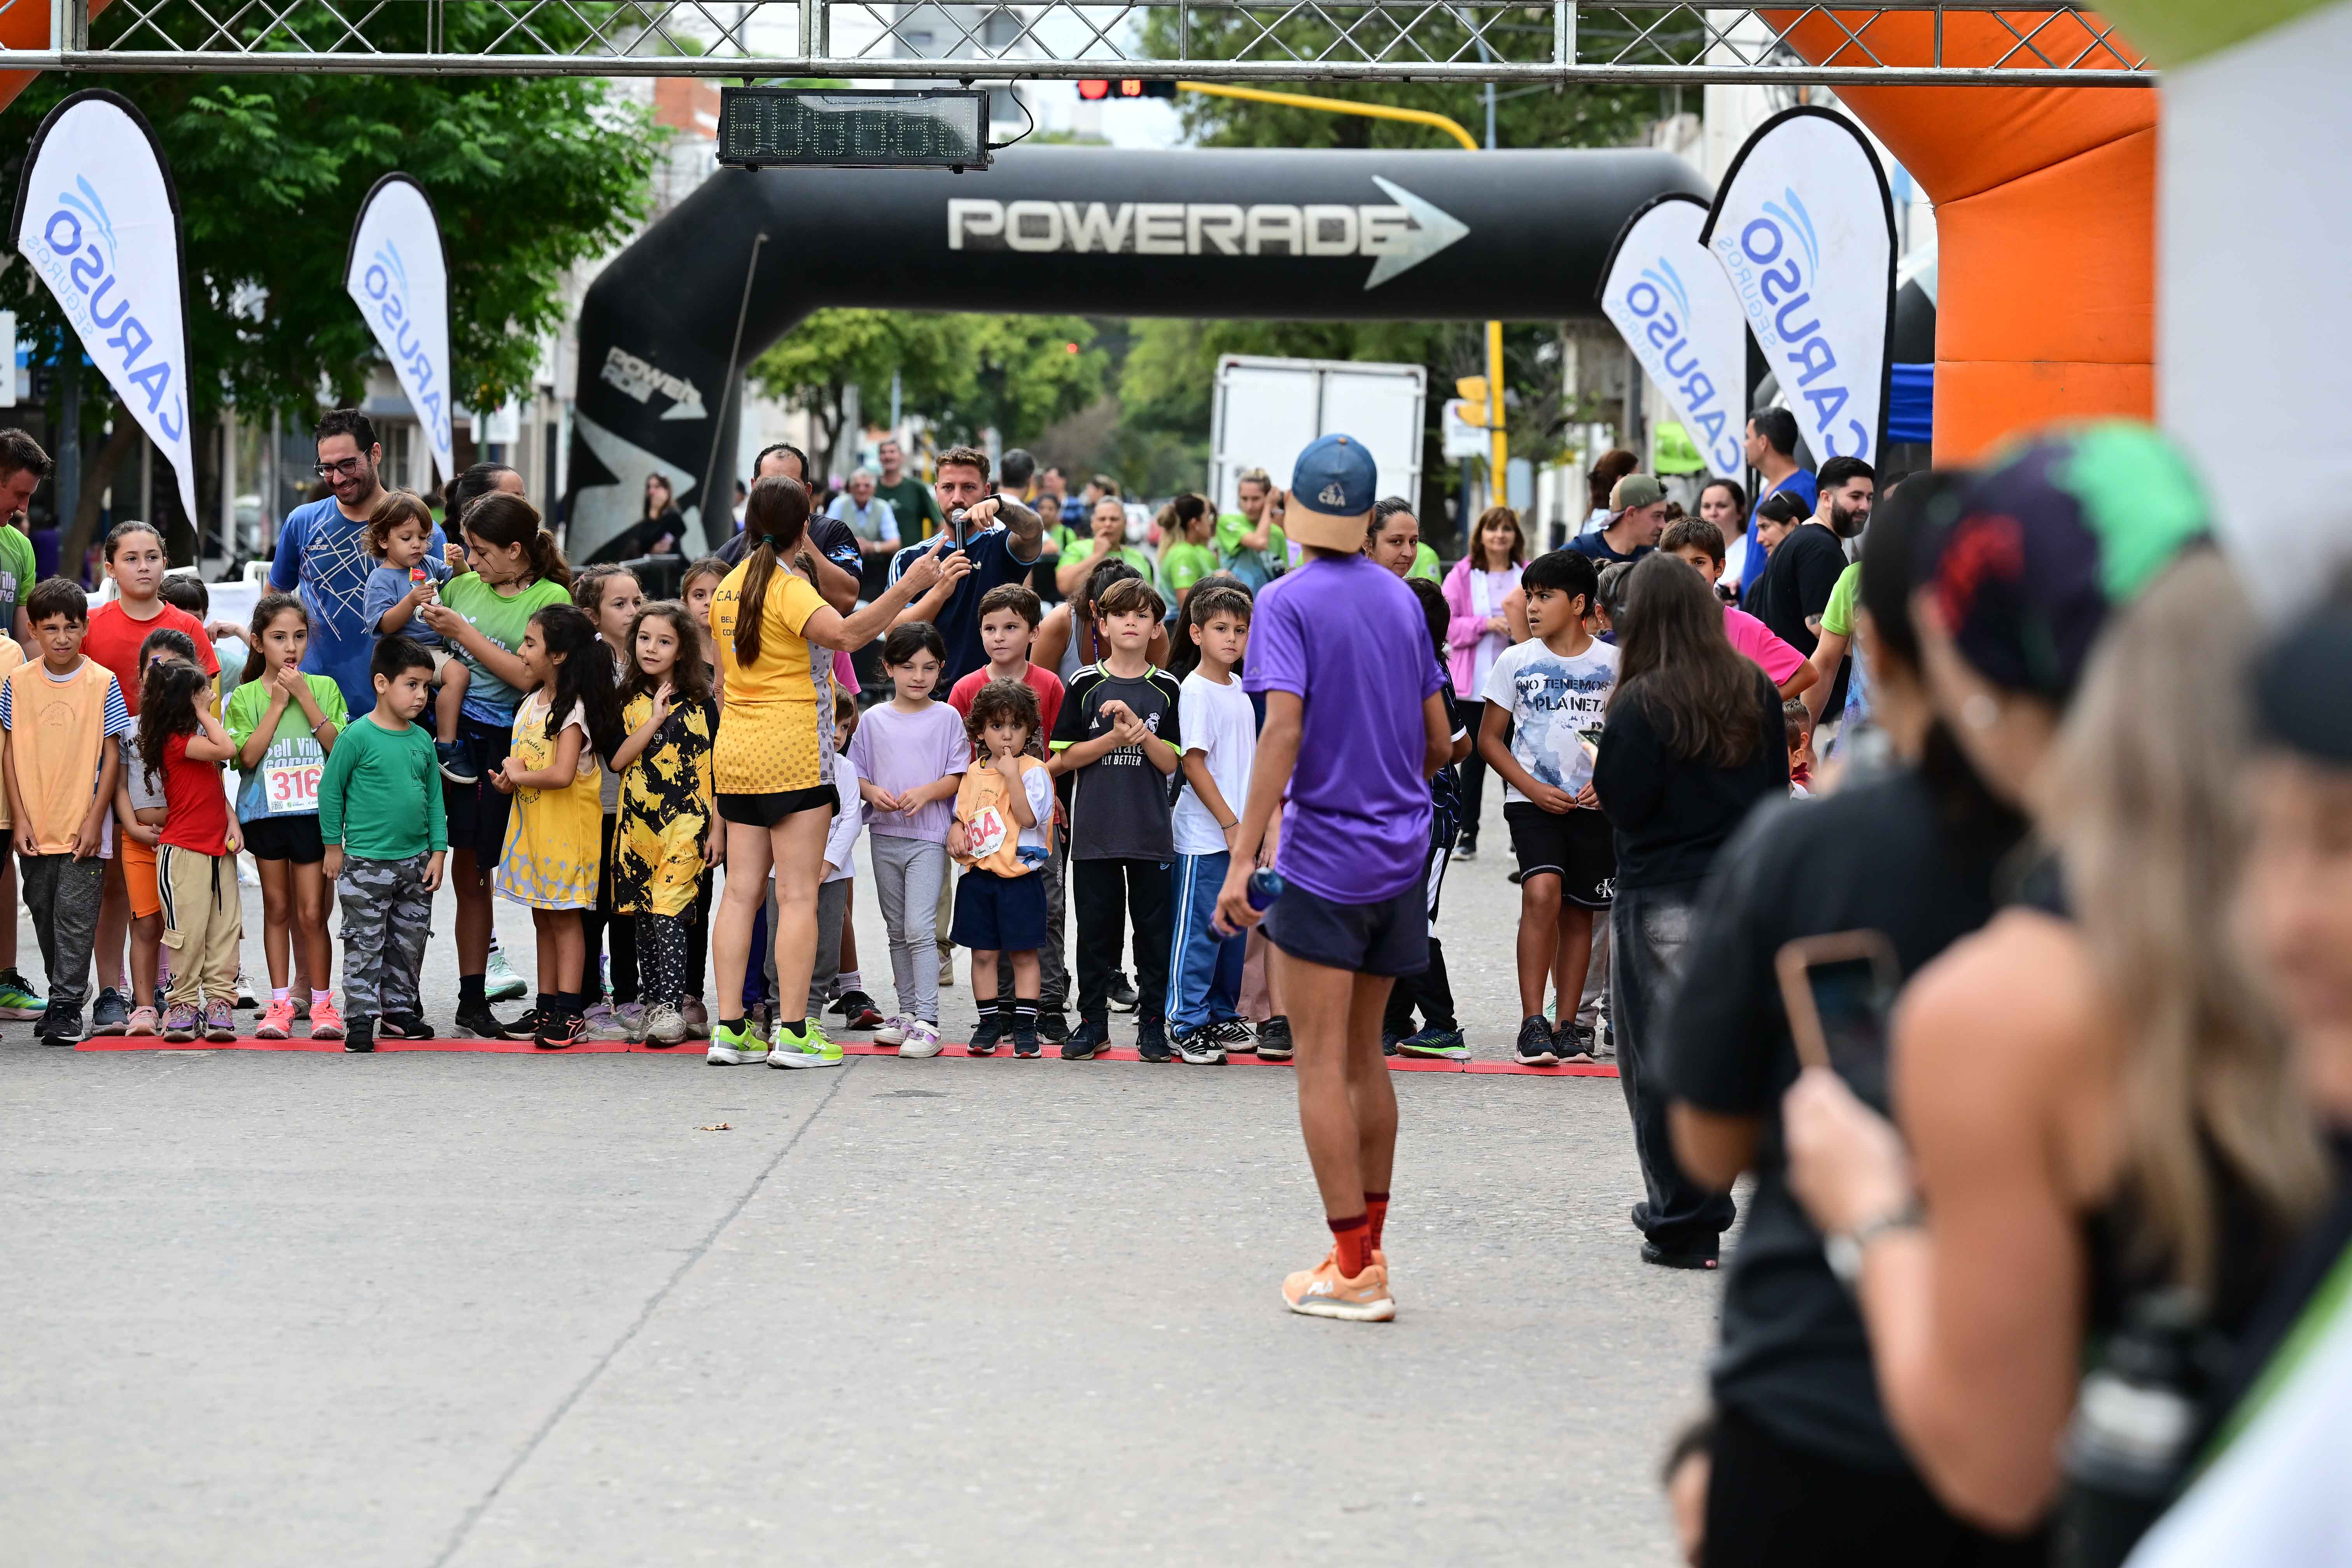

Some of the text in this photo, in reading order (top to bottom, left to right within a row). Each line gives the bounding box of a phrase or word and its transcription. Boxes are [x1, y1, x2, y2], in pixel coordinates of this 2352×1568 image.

[948, 198, 1409, 256] POWERADE
[0, 570, 16, 591] ille
[1102, 755, 1141, 766] FLY BETTER
[273, 768, 321, 800] 316
[808, 1038, 826, 1050] FILA
